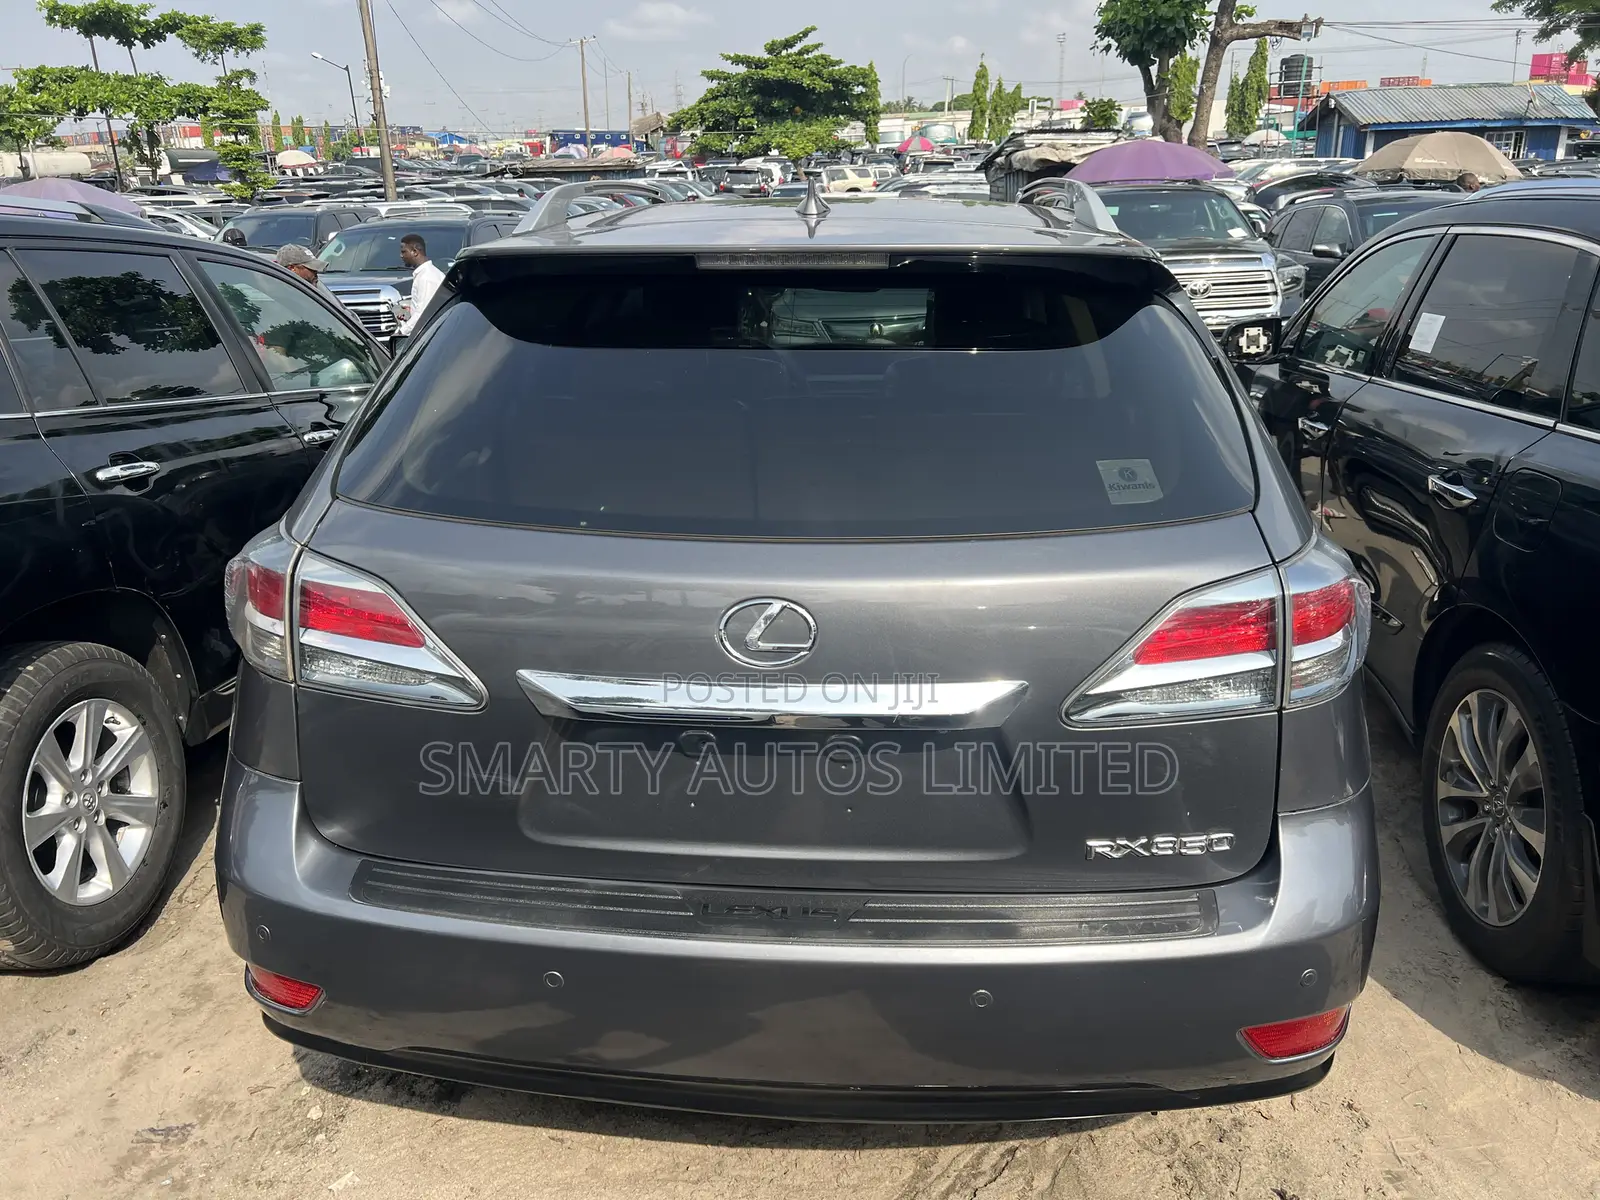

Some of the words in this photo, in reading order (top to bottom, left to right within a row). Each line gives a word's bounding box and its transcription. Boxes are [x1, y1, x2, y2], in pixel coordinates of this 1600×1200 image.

[1108, 481, 1155, 492] Kiwanis
[1085, 832, 1235, 860] RX350
[701, 903, 841, 924] LEXUS
